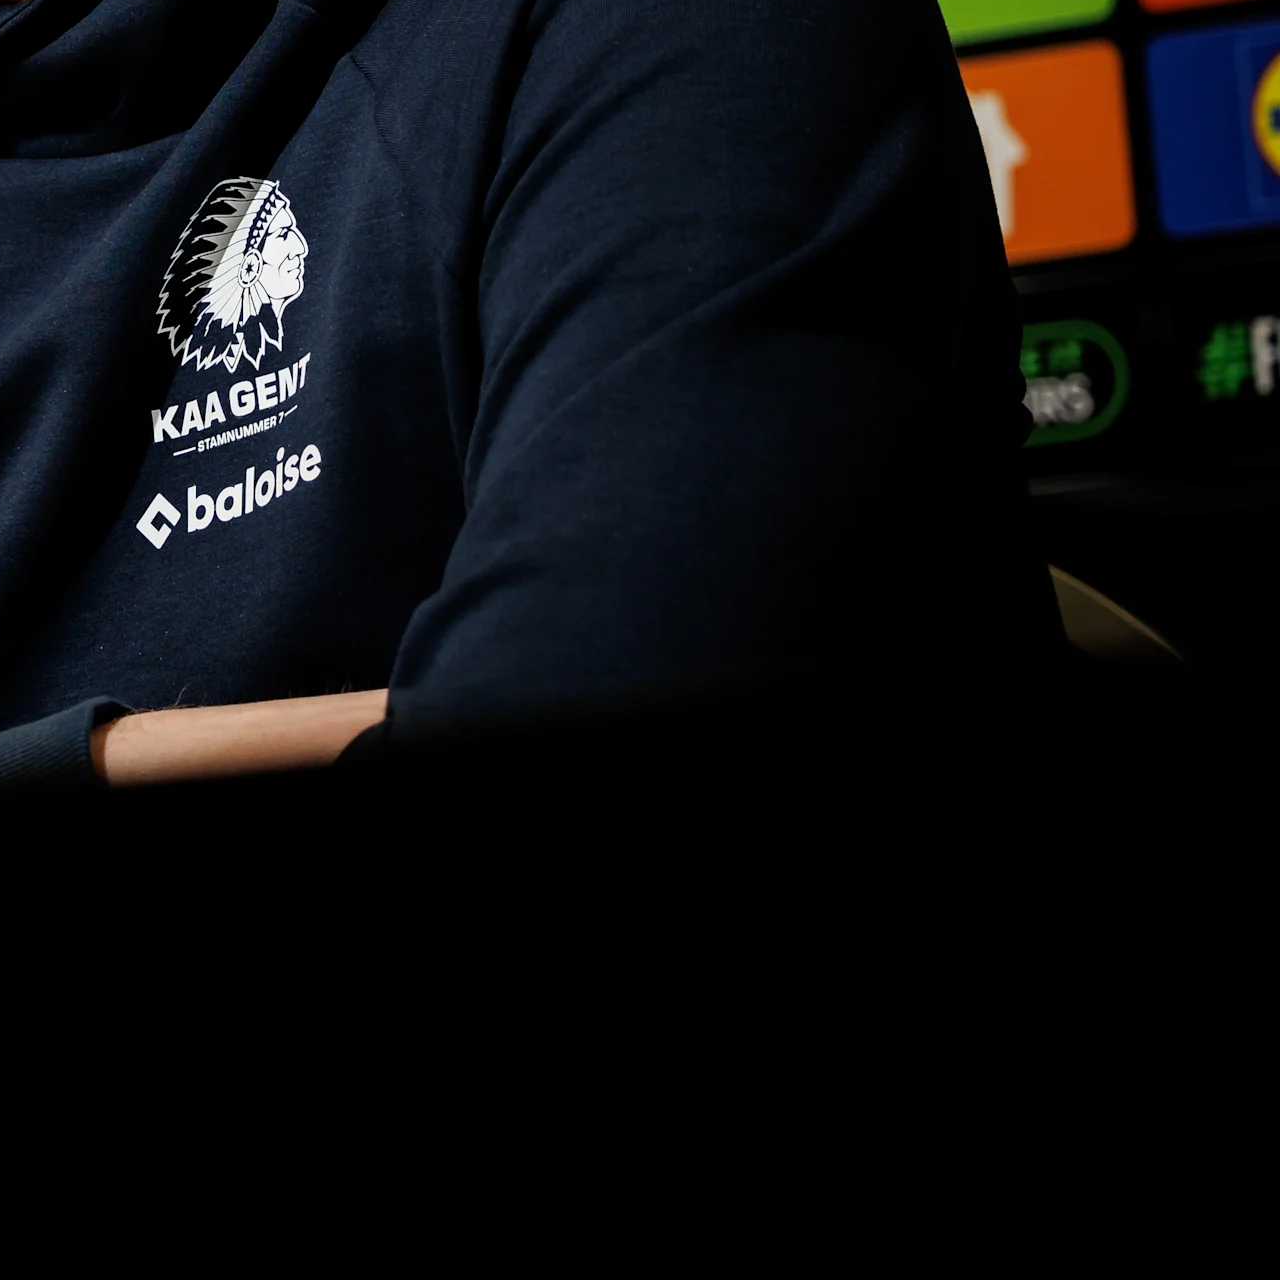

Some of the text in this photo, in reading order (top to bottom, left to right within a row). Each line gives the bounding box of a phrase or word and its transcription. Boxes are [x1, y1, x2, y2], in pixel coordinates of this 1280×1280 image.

[151, 352, 311, 444] KAA GENT
[197, 411, 285, 453] STAMNUMMER 7
[187, 444, 322, 533] baloise
